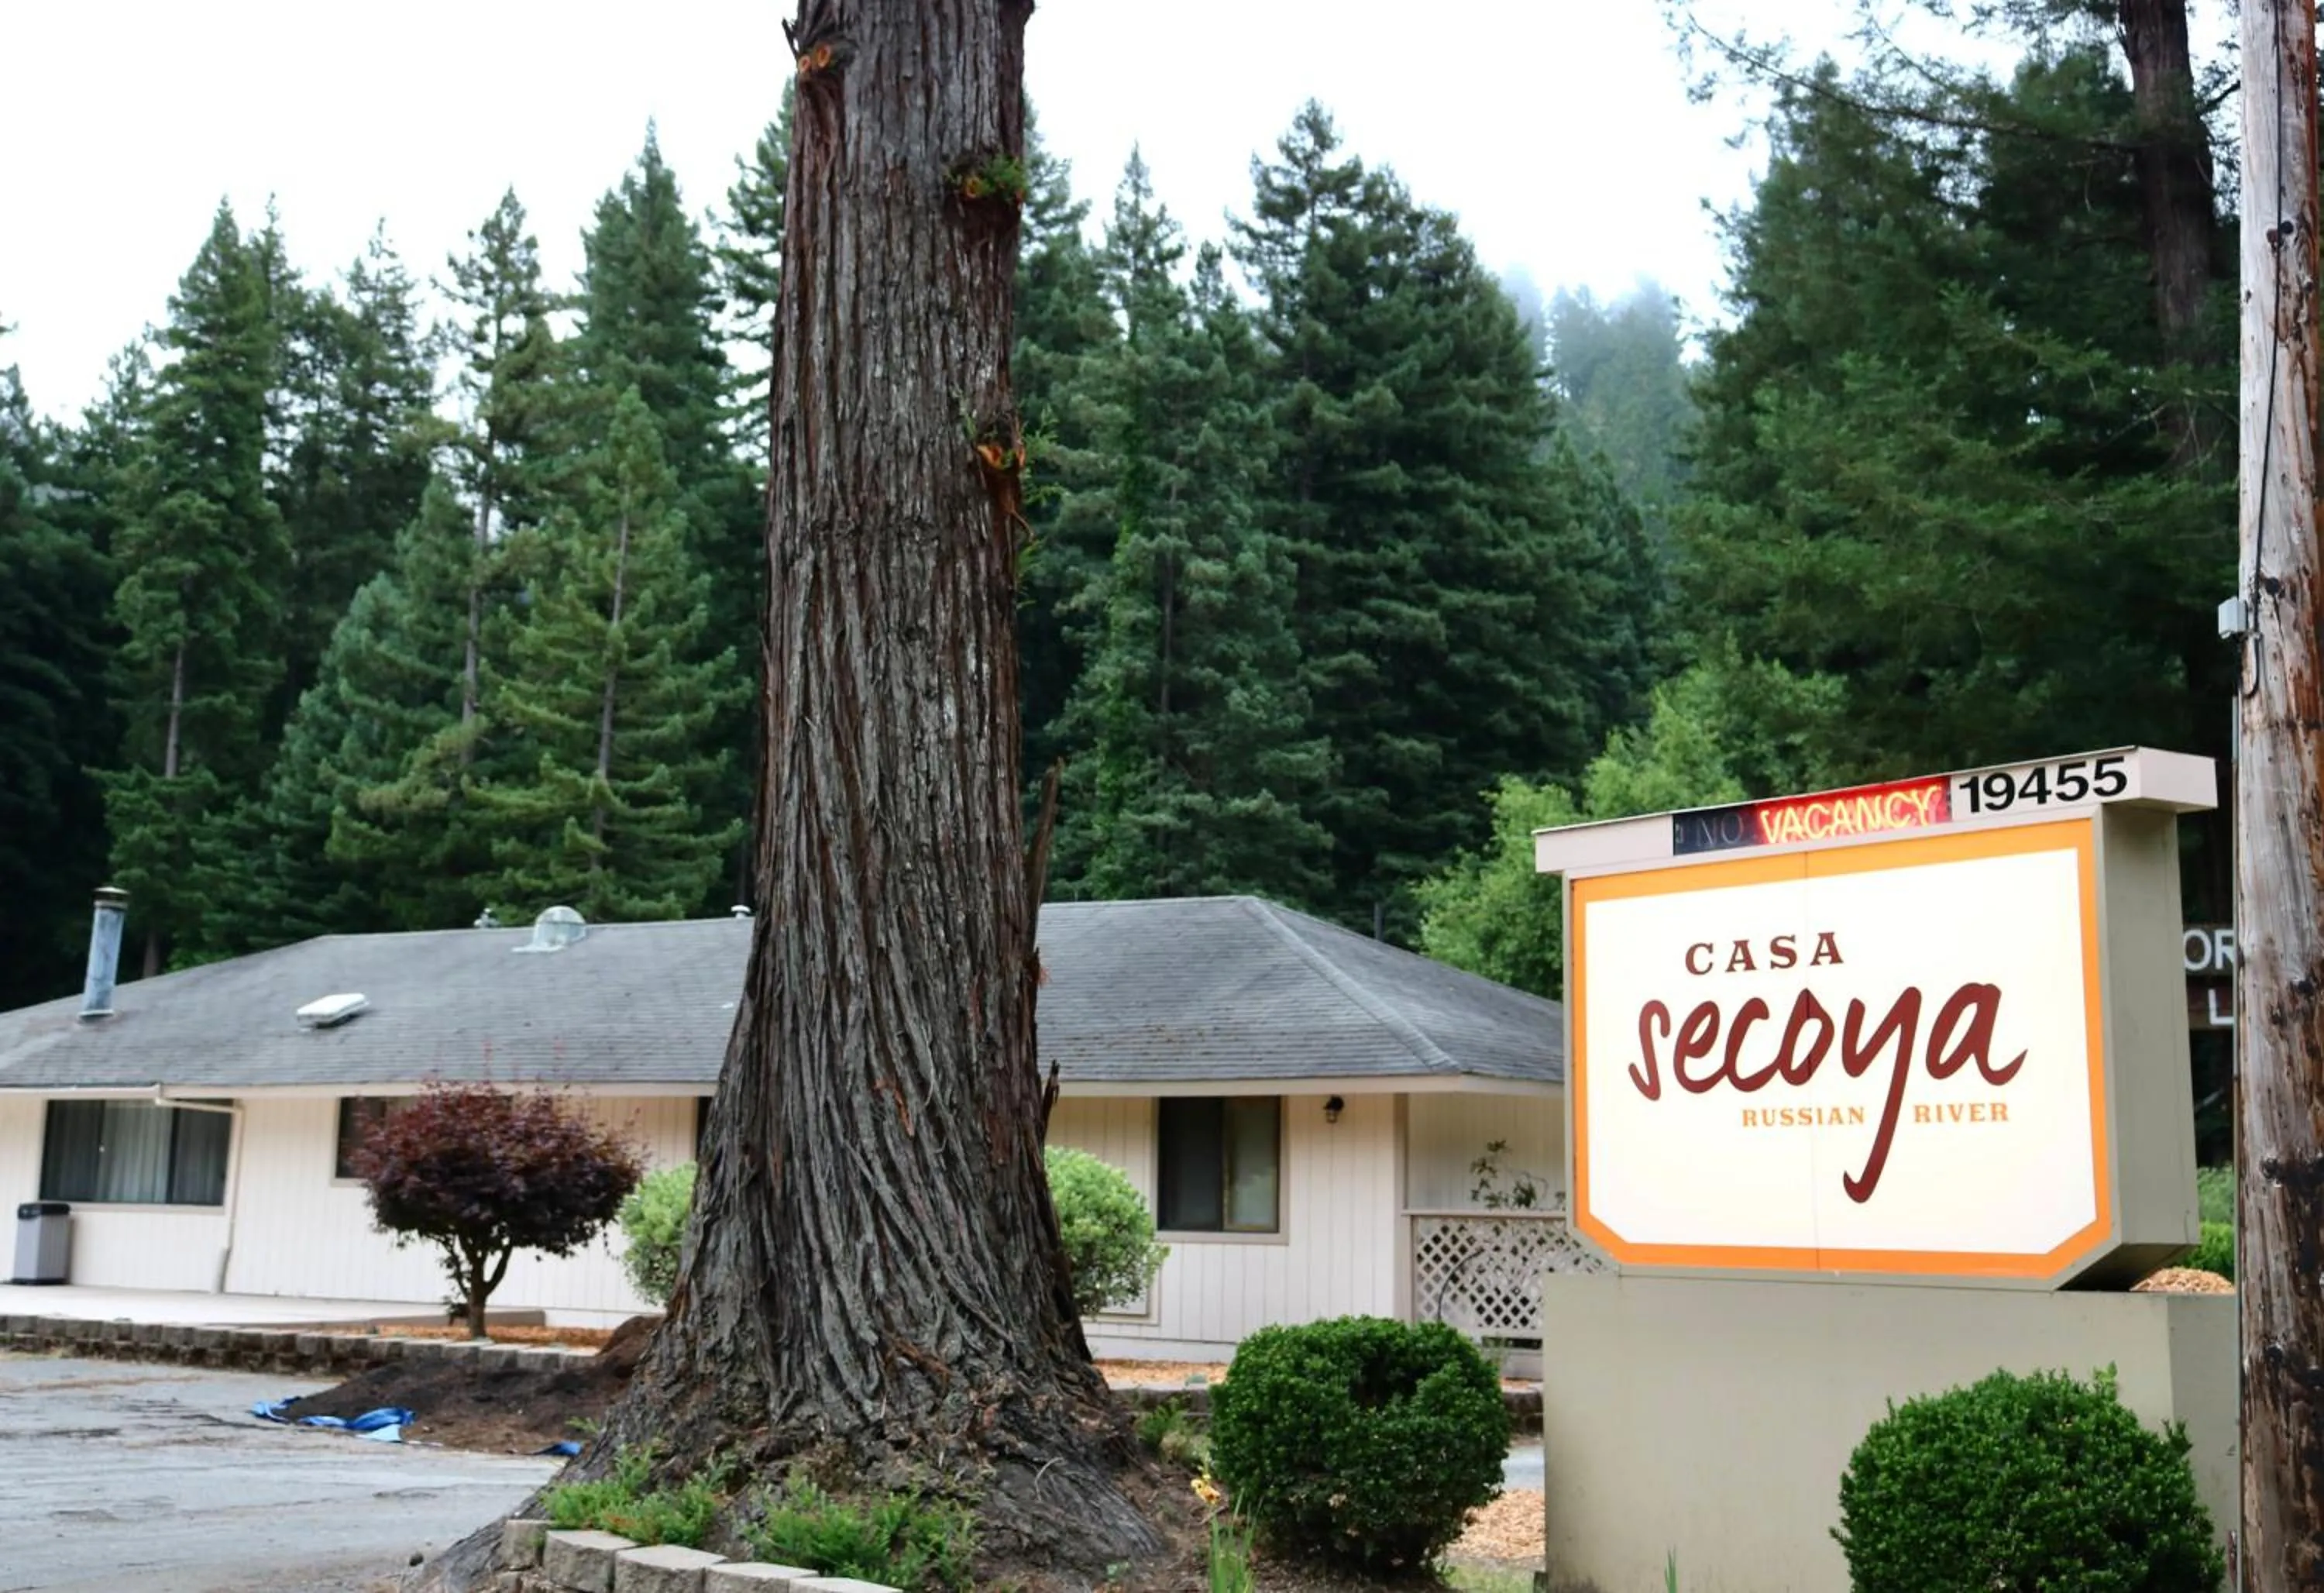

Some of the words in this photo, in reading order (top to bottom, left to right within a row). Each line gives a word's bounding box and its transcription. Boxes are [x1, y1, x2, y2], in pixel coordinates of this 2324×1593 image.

[1959, 756, 2128, 814] 19455
[1697, 811, 1745, 848] NO
[1759, 785, 1941, 844] VACANCY
[1685, 931, 1844, 975] CASA
[1628, 982, 2027, 1204] secoya
[1741, 1106, 1865, 1128] RUSSIAN
[1913, 1101, 2009, 1124] RIVER
